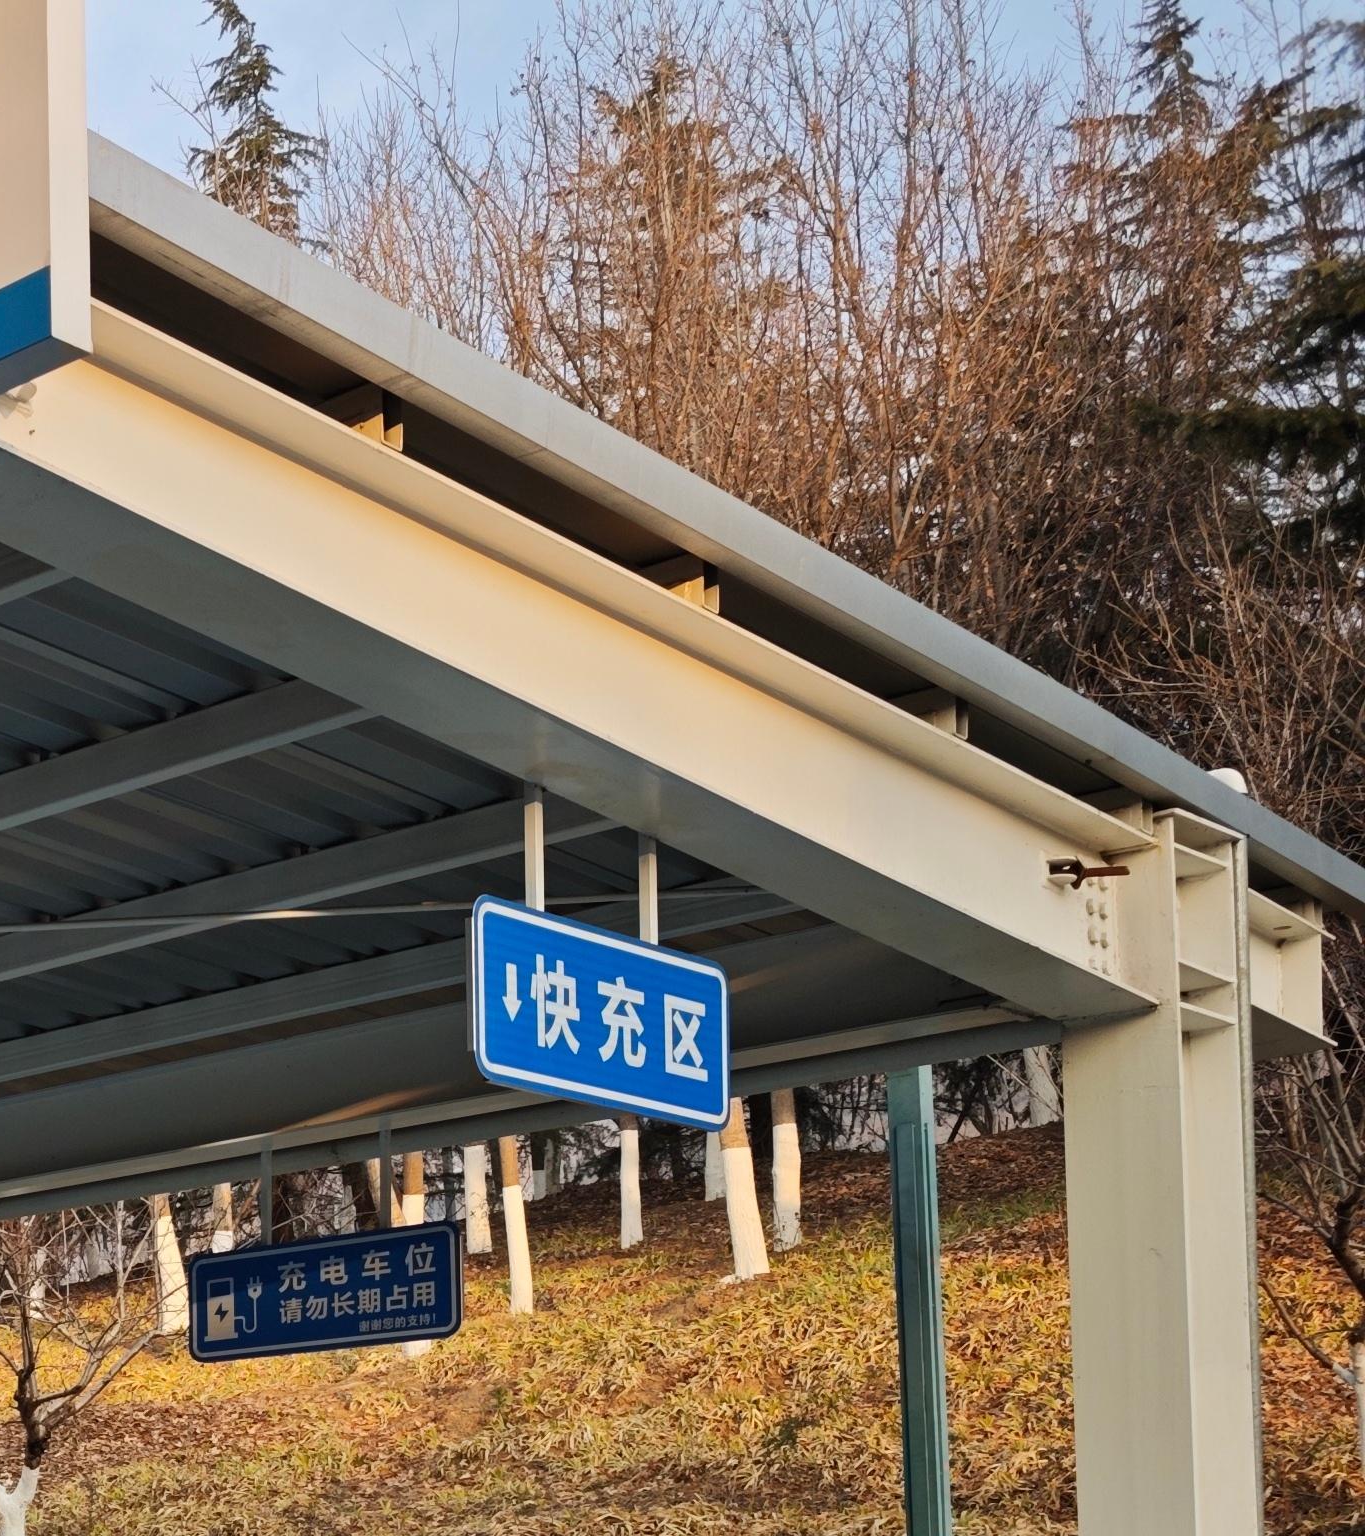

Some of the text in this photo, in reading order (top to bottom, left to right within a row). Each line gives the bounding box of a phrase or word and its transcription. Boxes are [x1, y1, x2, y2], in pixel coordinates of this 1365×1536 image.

[530, 953, 708, 1082] 快充区
[277, 1242, 437, 1294] 充电车位
[278, 1280, 436, 1325] 请勿长期占用
